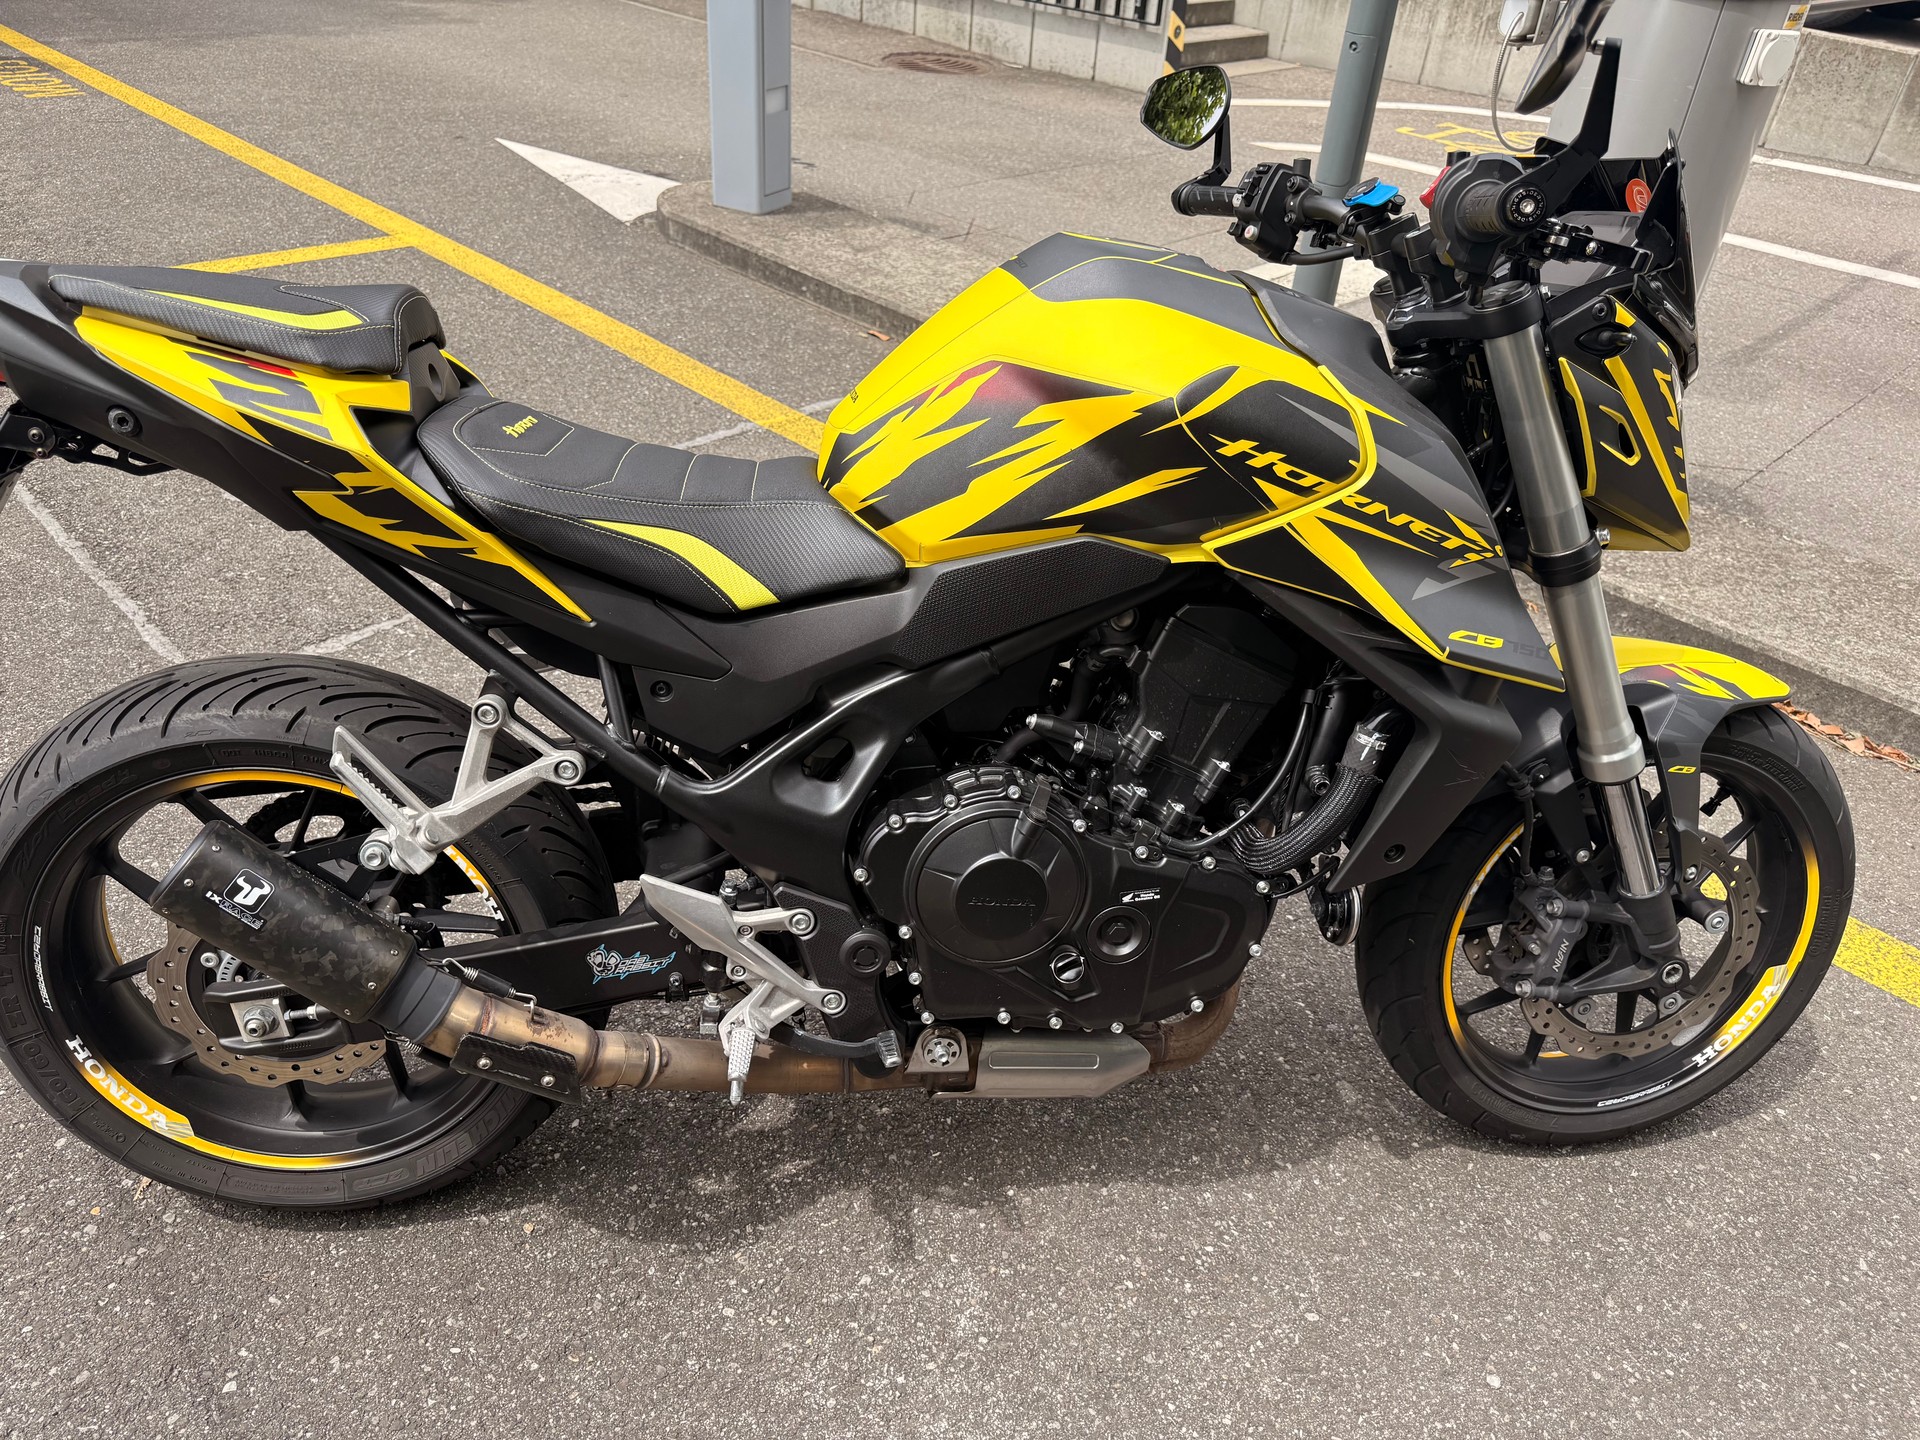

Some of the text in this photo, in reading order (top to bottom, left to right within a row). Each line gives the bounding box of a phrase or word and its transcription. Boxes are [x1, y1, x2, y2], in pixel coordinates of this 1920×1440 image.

[1448, 629, 1504, 649] CB
[1667, 765, 1697, 774] CB
[1552, 938, 1569, 973] NISSIN
[1691, 984, 1781, 1068] HONDA
[65, 1034, 169, 1131] HONDA
